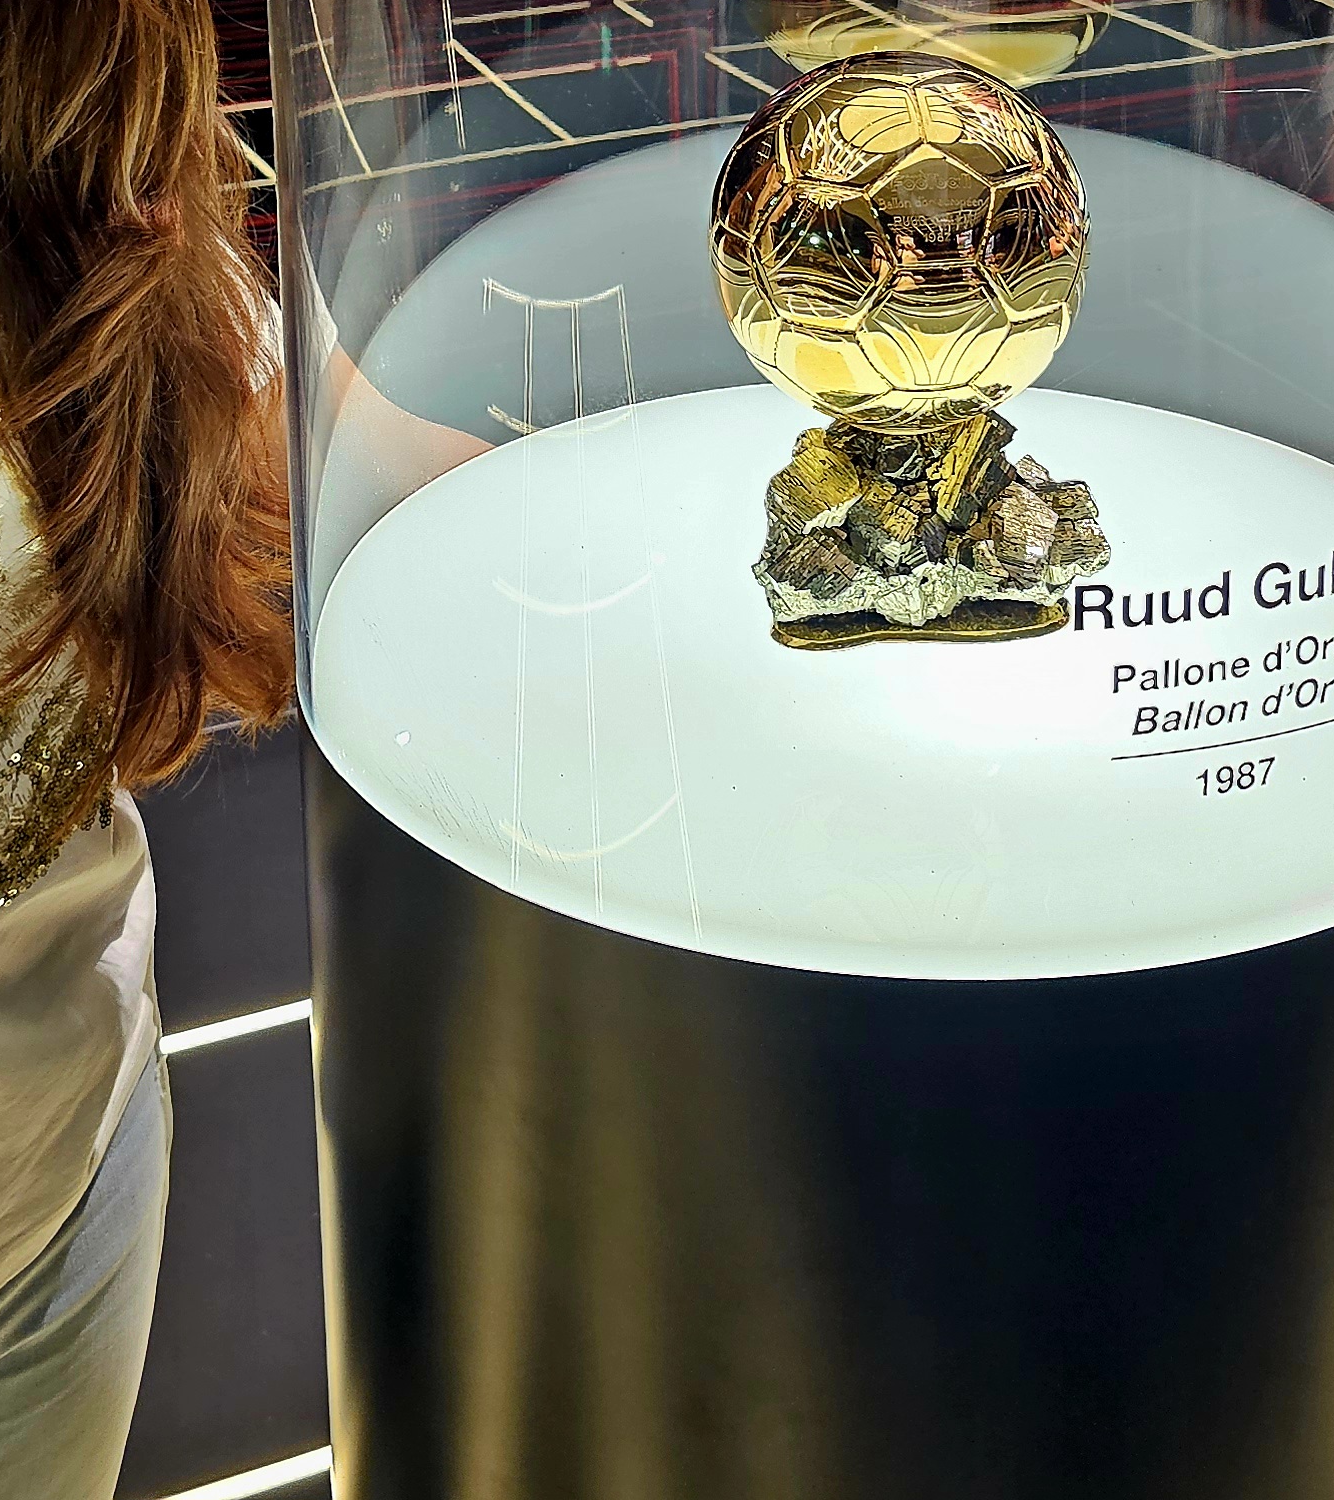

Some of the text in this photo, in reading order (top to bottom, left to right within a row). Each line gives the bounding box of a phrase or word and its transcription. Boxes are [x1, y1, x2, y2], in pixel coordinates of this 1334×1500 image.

[1073, 570, 1232, 631] Ruud
[1112, 656, 1251, 694] Pallone
[1131, 699, 1249, 737] Ballon
[1195, 756, 1276, 797] 1987
